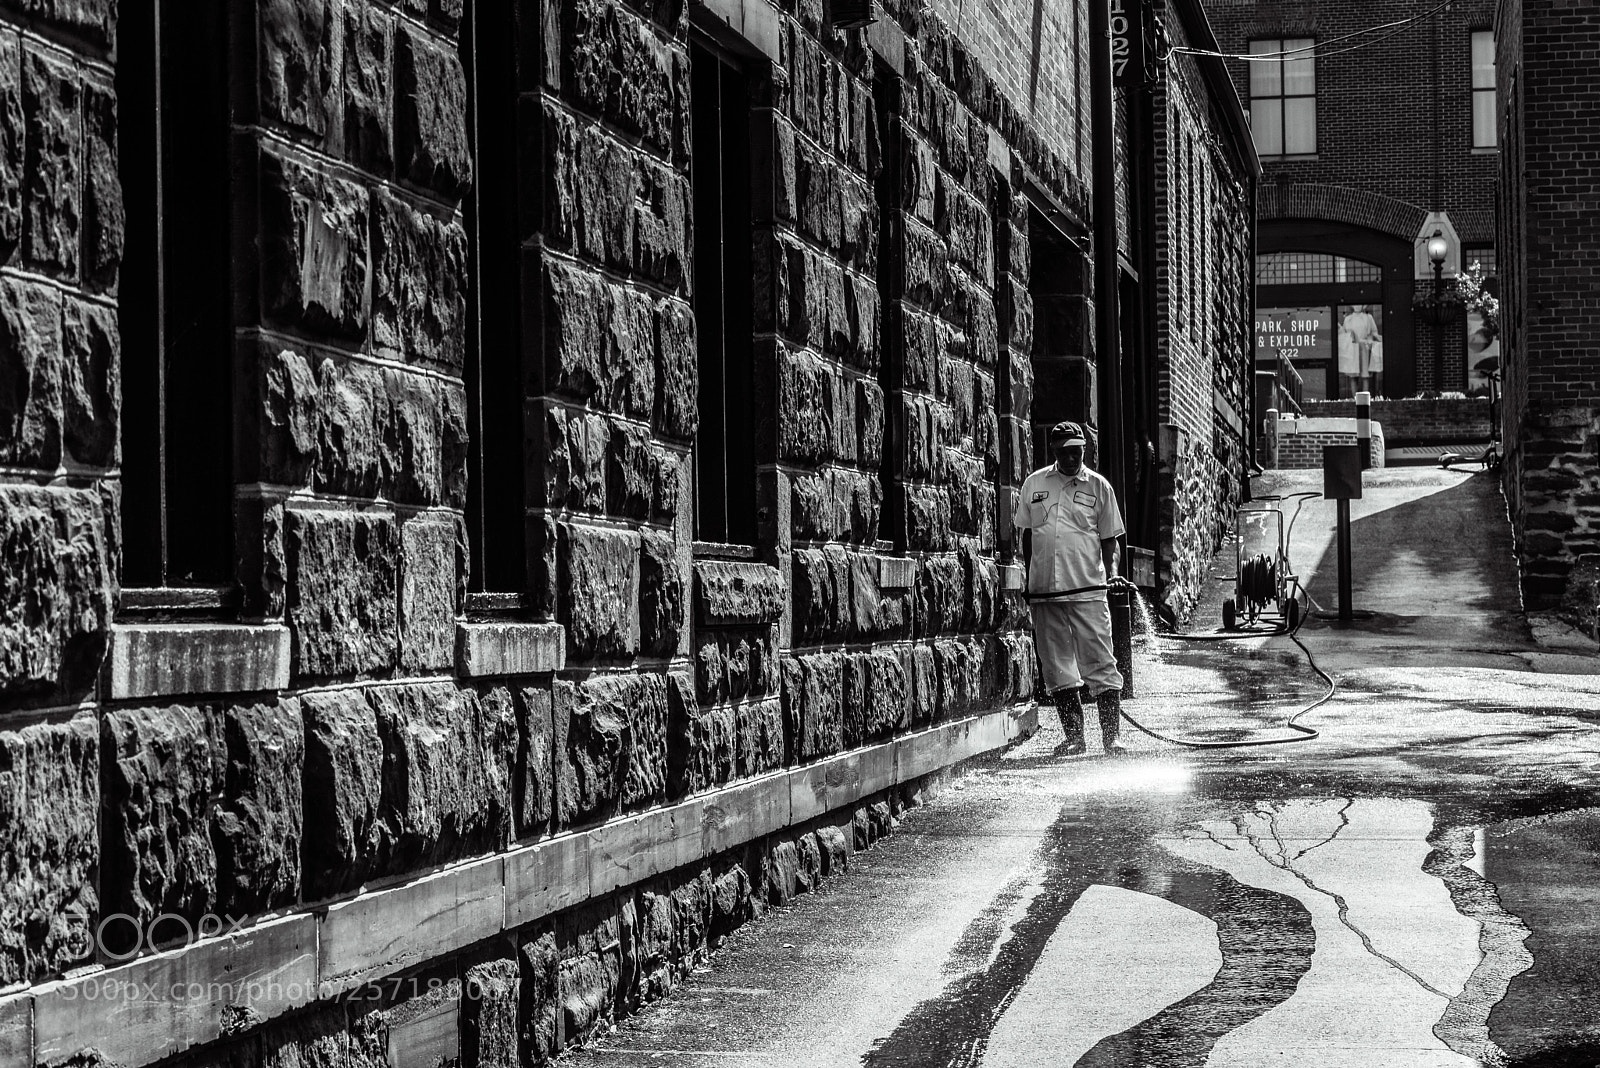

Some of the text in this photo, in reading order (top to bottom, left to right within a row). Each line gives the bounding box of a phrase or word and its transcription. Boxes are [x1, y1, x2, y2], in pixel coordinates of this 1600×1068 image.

[1111, 0, 1130, 77] 1027
[1255, 319, 1319, 333] PARK, SHOP
[1258, 334, 1316, 347] & EXPLORE
